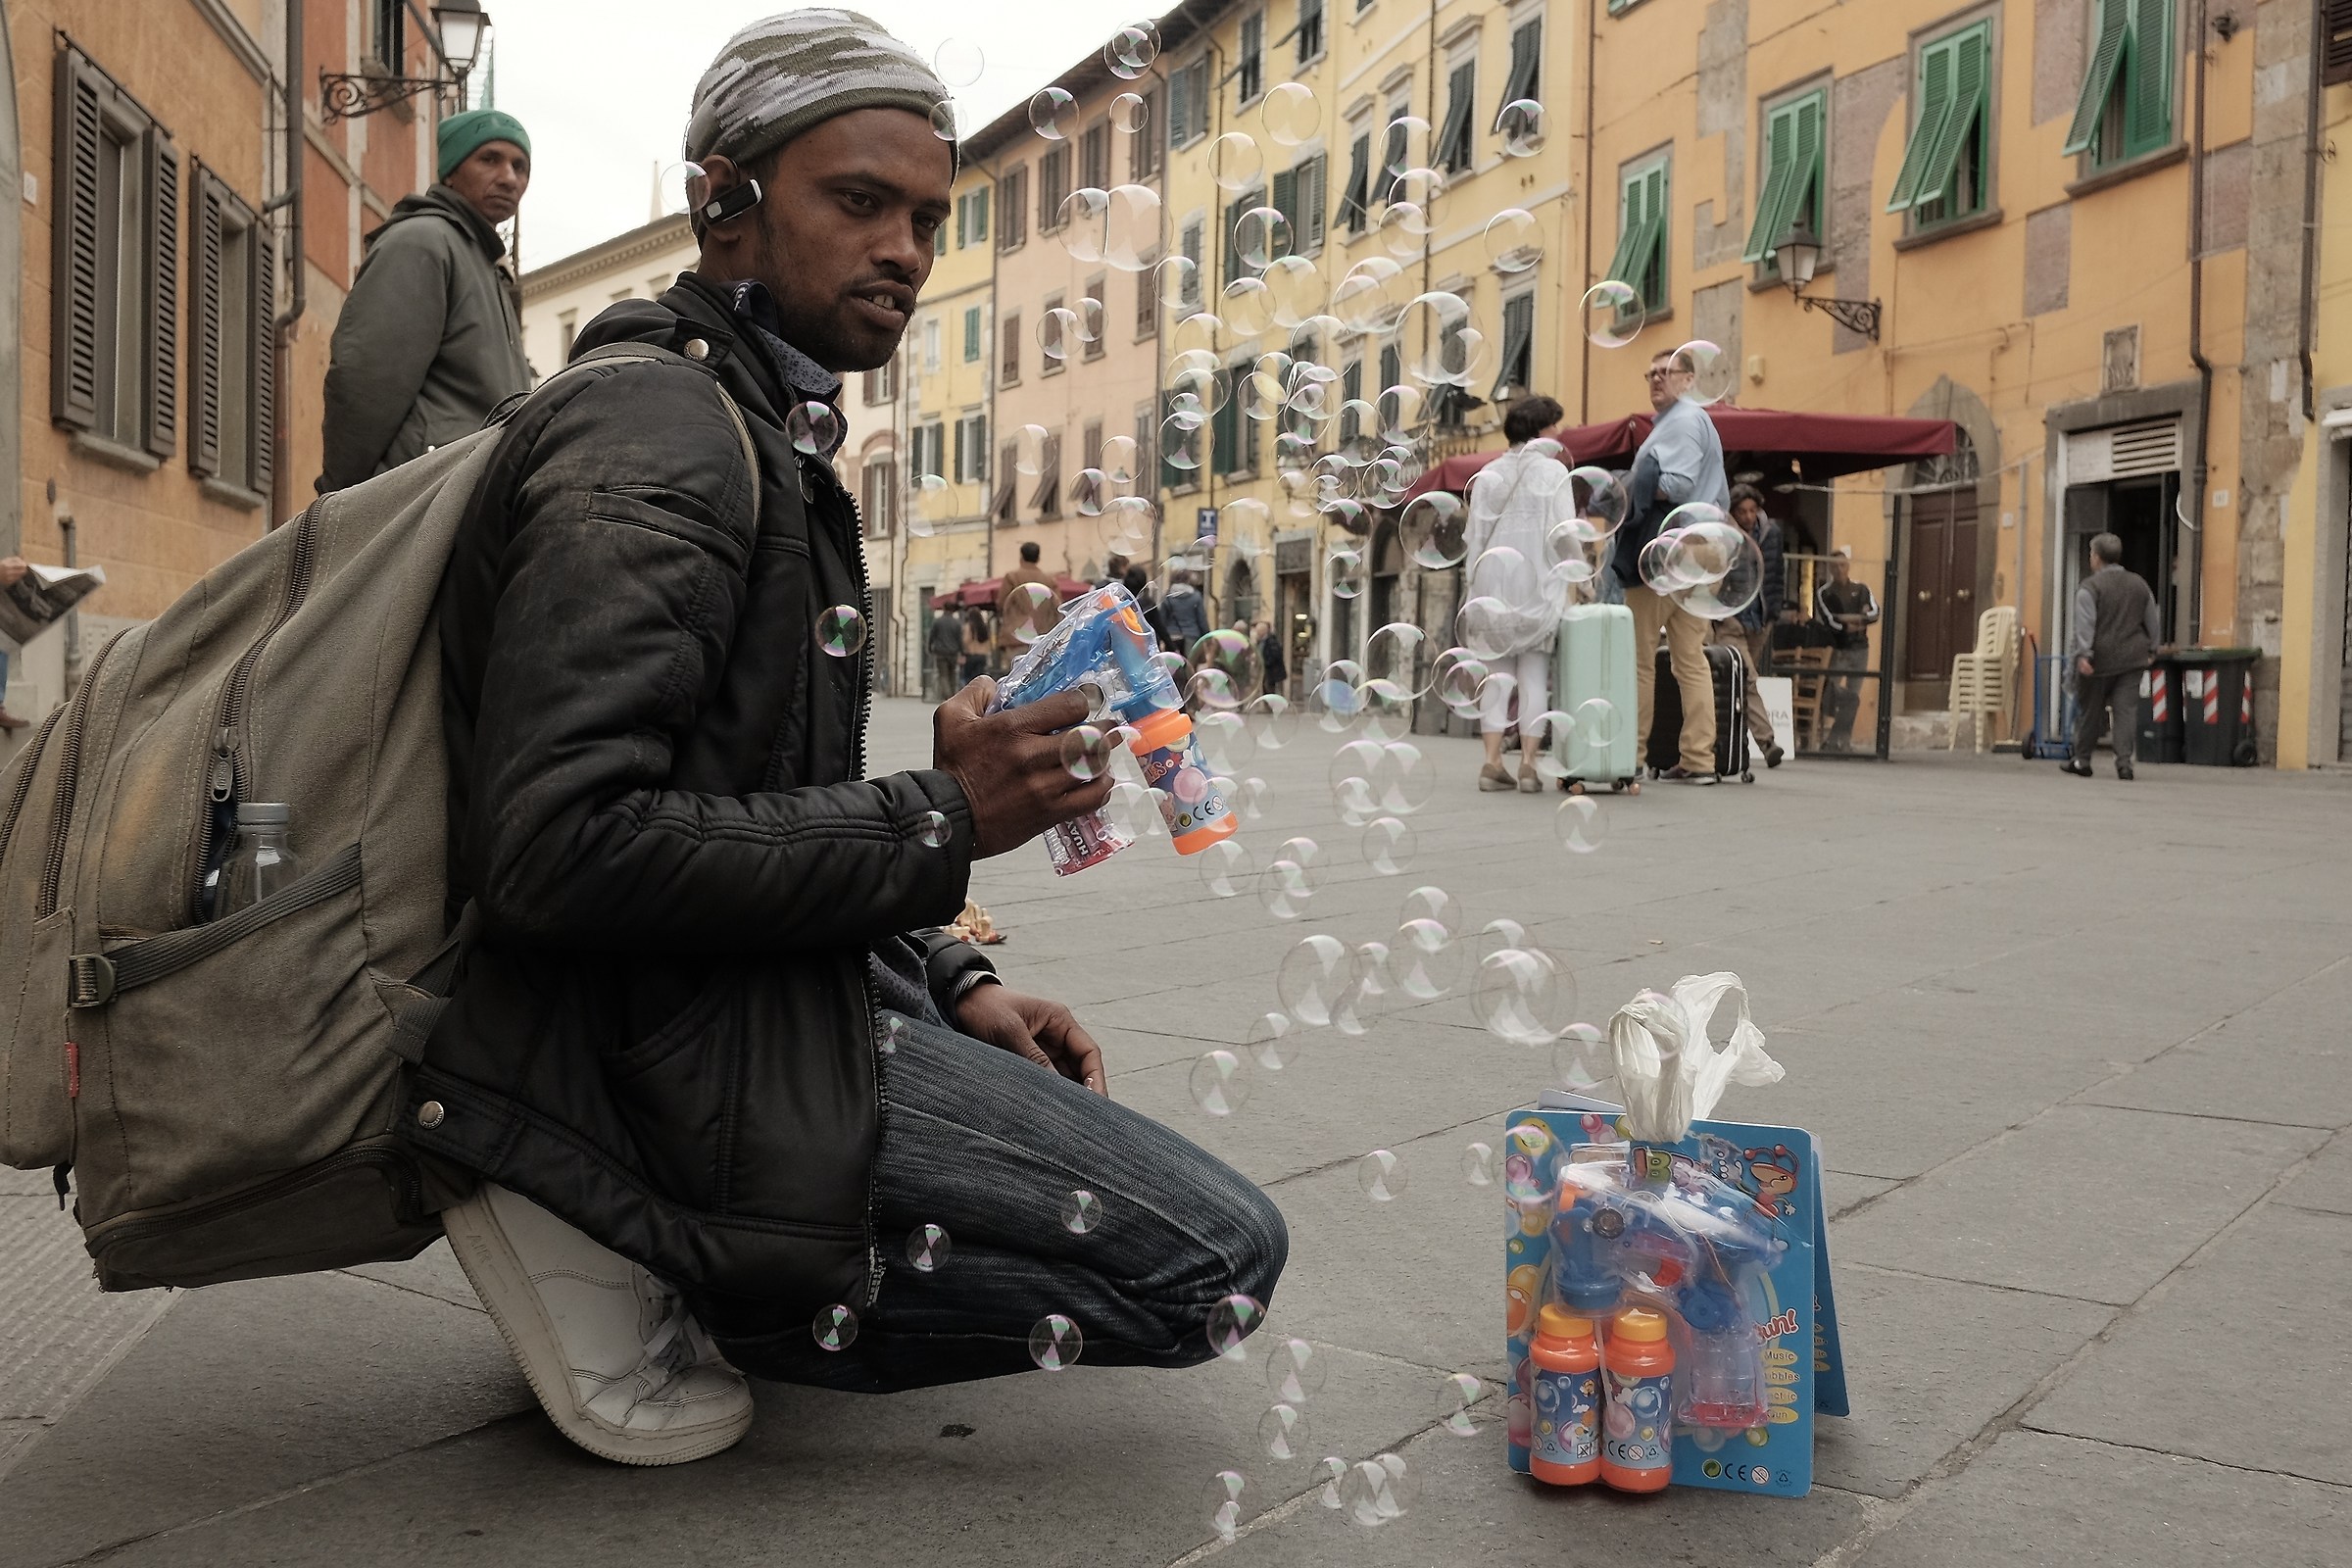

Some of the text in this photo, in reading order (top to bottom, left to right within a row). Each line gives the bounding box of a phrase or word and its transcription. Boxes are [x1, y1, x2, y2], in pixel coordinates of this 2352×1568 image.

[466, 1235, 492, 1263] AIR
[1764, 1351, 1794, 1361] Music
[1764, 1372, 1801, 1383] ubbles
[1725, 1463, 1746, 1482] CE
